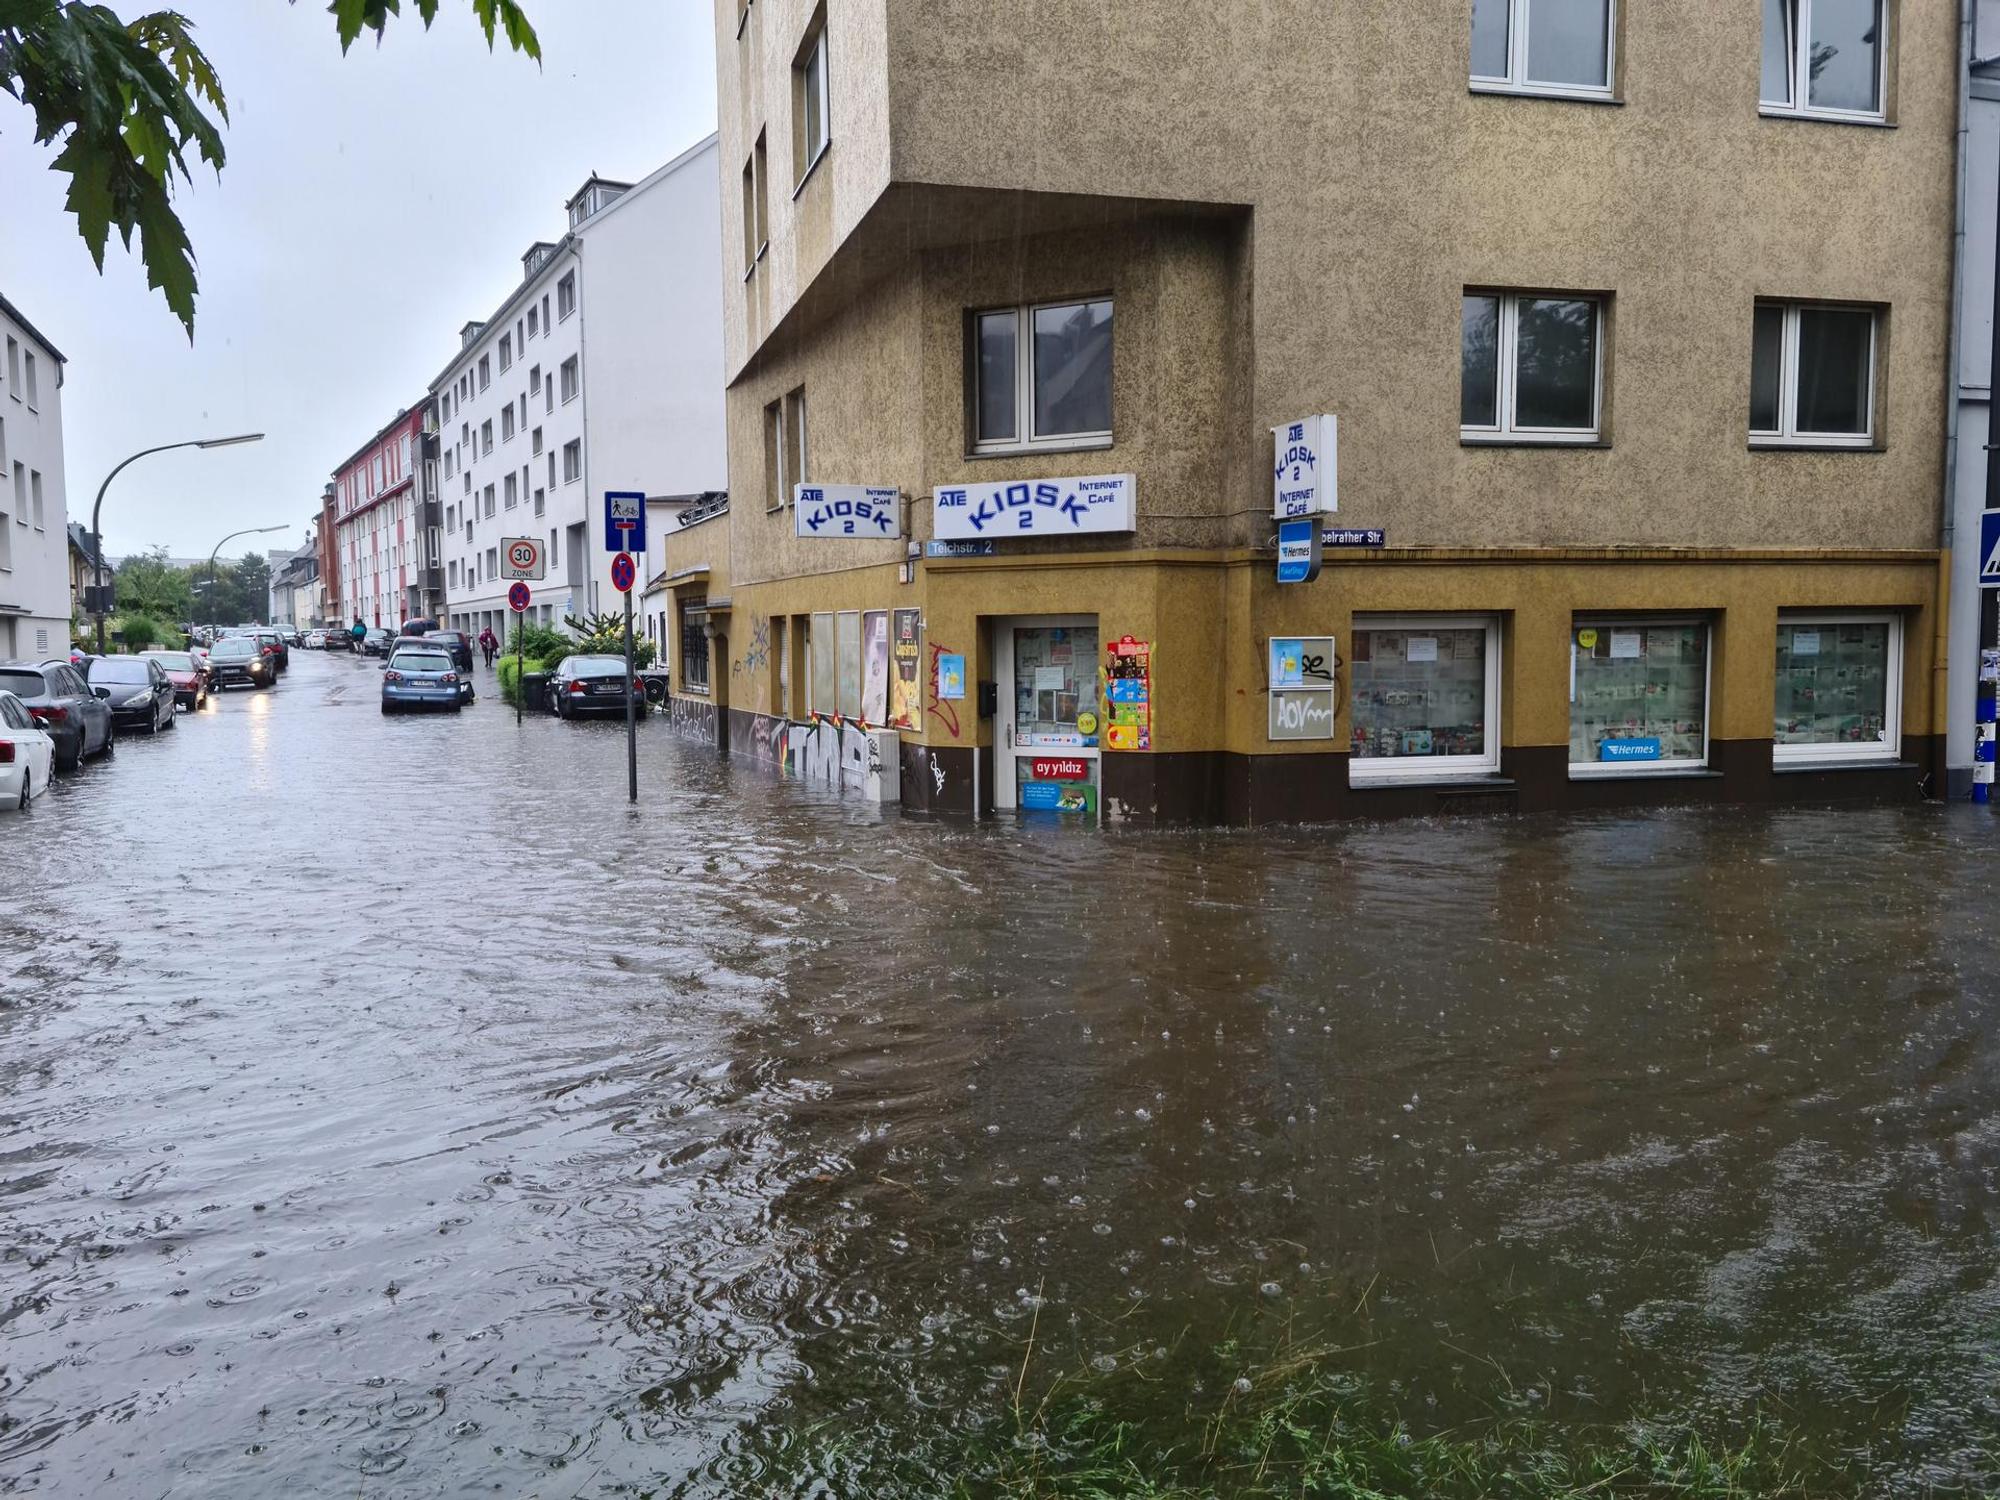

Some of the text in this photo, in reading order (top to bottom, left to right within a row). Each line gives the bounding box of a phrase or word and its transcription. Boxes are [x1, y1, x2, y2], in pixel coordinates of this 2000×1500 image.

[1276, 446, 1315, 480] KIOSK
[1294, 466, 1300, 481] 2
[800, 489, 824, 501] ATE
[938, 490, 966, 507] ATE
[968, 483, 1090, 532] KIOSK
[807, 500, 893, 533] KIOSK
[1019, 511, 1032, 528] 2
[844, 520, 854, 533] 2
[1367, 531, 1382, 543] Str.
[984, 541, 992, 553] 2
[1288, 546, 1310, 557] Hermes
[515, 549, 531, 562] 30
[1618, 745, 1654, 754] Hermes
[1037, 764, 1050, 775] ay
